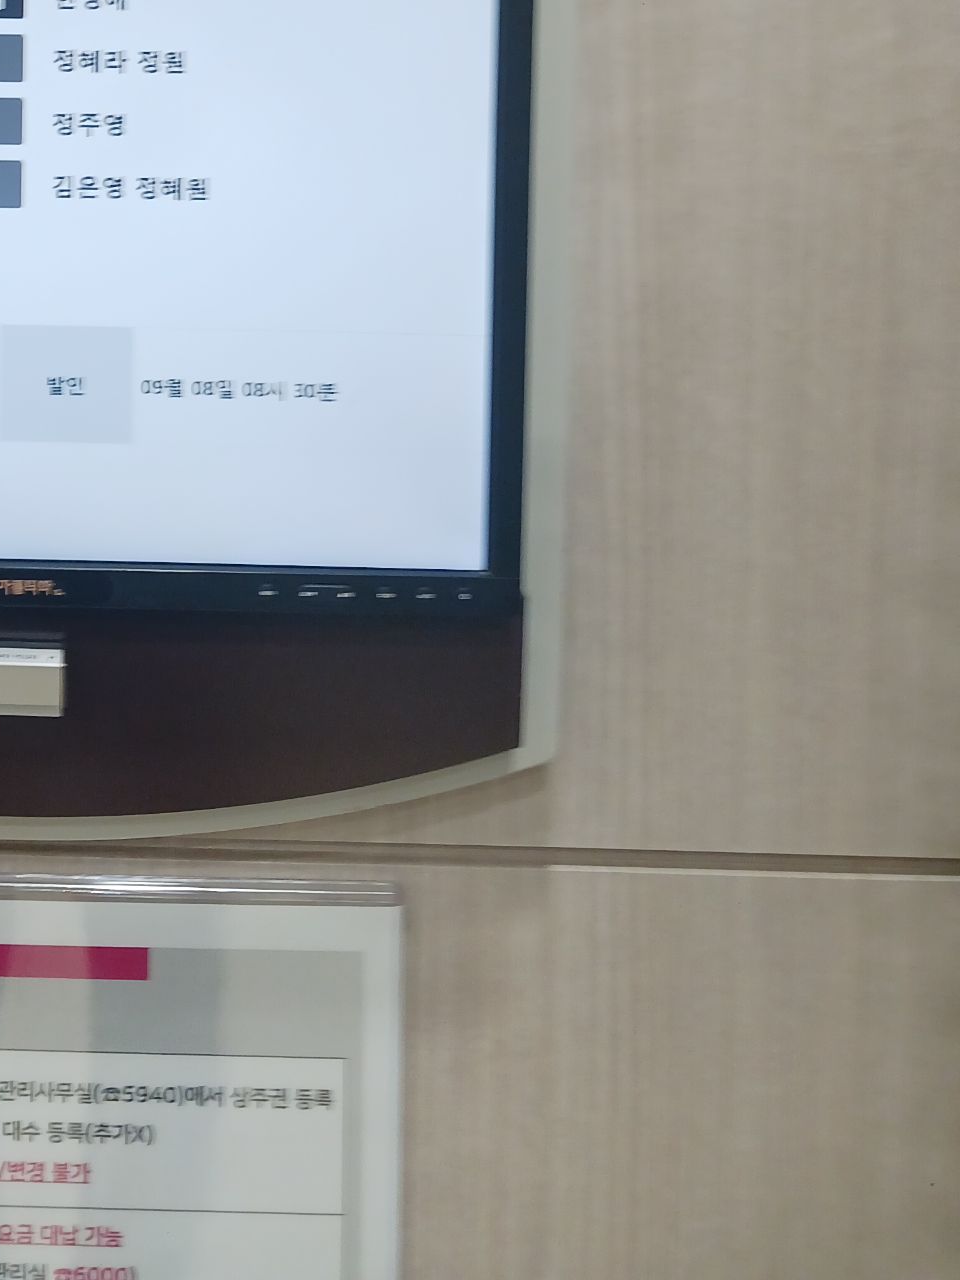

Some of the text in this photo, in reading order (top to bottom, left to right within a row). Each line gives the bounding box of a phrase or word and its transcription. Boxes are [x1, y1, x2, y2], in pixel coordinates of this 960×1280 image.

[53, 49, 128, 74] 정혜라
[52, 113, 127, 138] 정주영
[52, 175, 126, 199] 김은영
[46, 376, 86, 397] 발인
[141, 378, 339, 403] 09월 08일 08시 30분
[229, 1086, 288, 1110] 상주권
[294, 1088, 335, 1110] 등록
[1, 1121, 41, 1143] 대수
[51, 1162, 91, 1184] 불가
[40, 1225, 79, 1246] 대납
[85, 1226, 124, 1248] 가능
